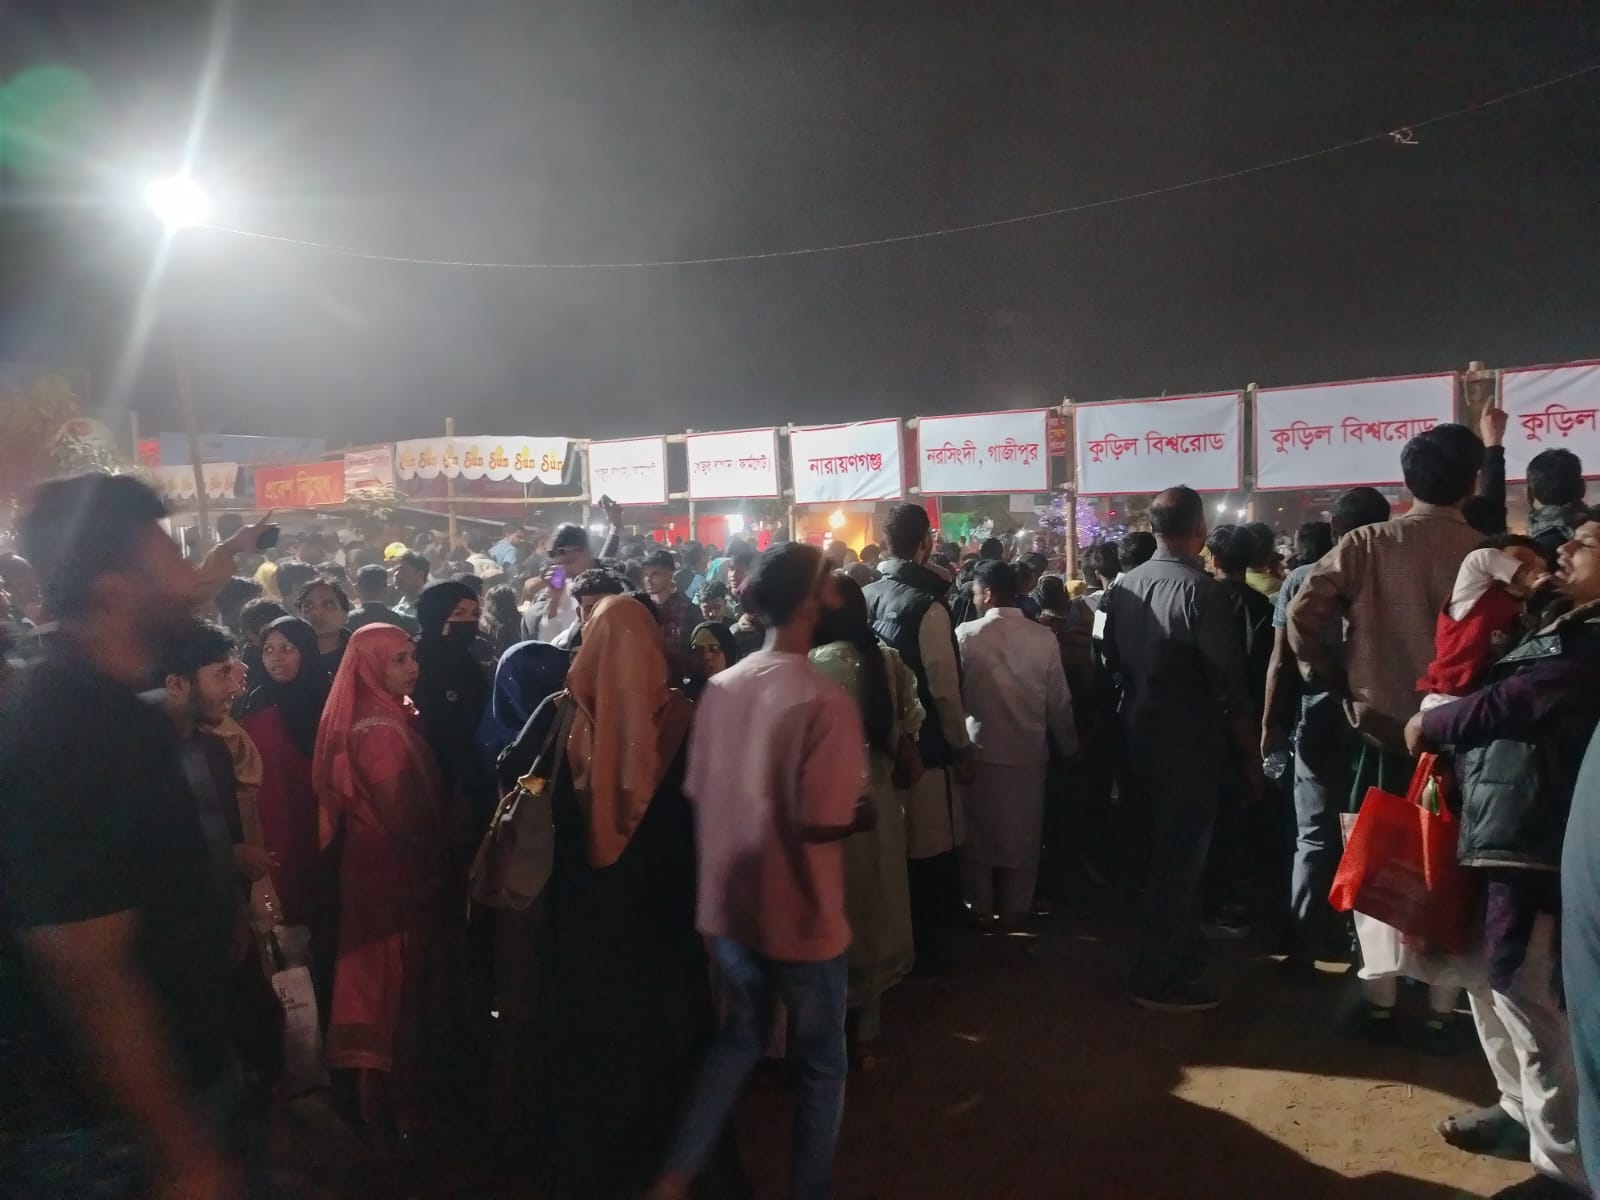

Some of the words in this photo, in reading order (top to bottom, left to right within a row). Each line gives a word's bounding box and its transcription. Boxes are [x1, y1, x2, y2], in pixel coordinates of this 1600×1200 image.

[1270, 420, 1334, 454] কুড়িল
[1518, 403, 1599, 442] কুড়িল
[464, 451, 484, 468] Sun
[489, 451, 509, 470] Sun
[514, 453, 535, 471] Sun
[541, 454, 564, 473] Sun
[988, 437, 1039, 466] গাজীপুর
[1088, 433, 1139, 463] কুড়িল
[1145, 431, 1225, 457] বিশ্বরোড
[808, 452, 882, 476] নারায়ণগঞ্জ
